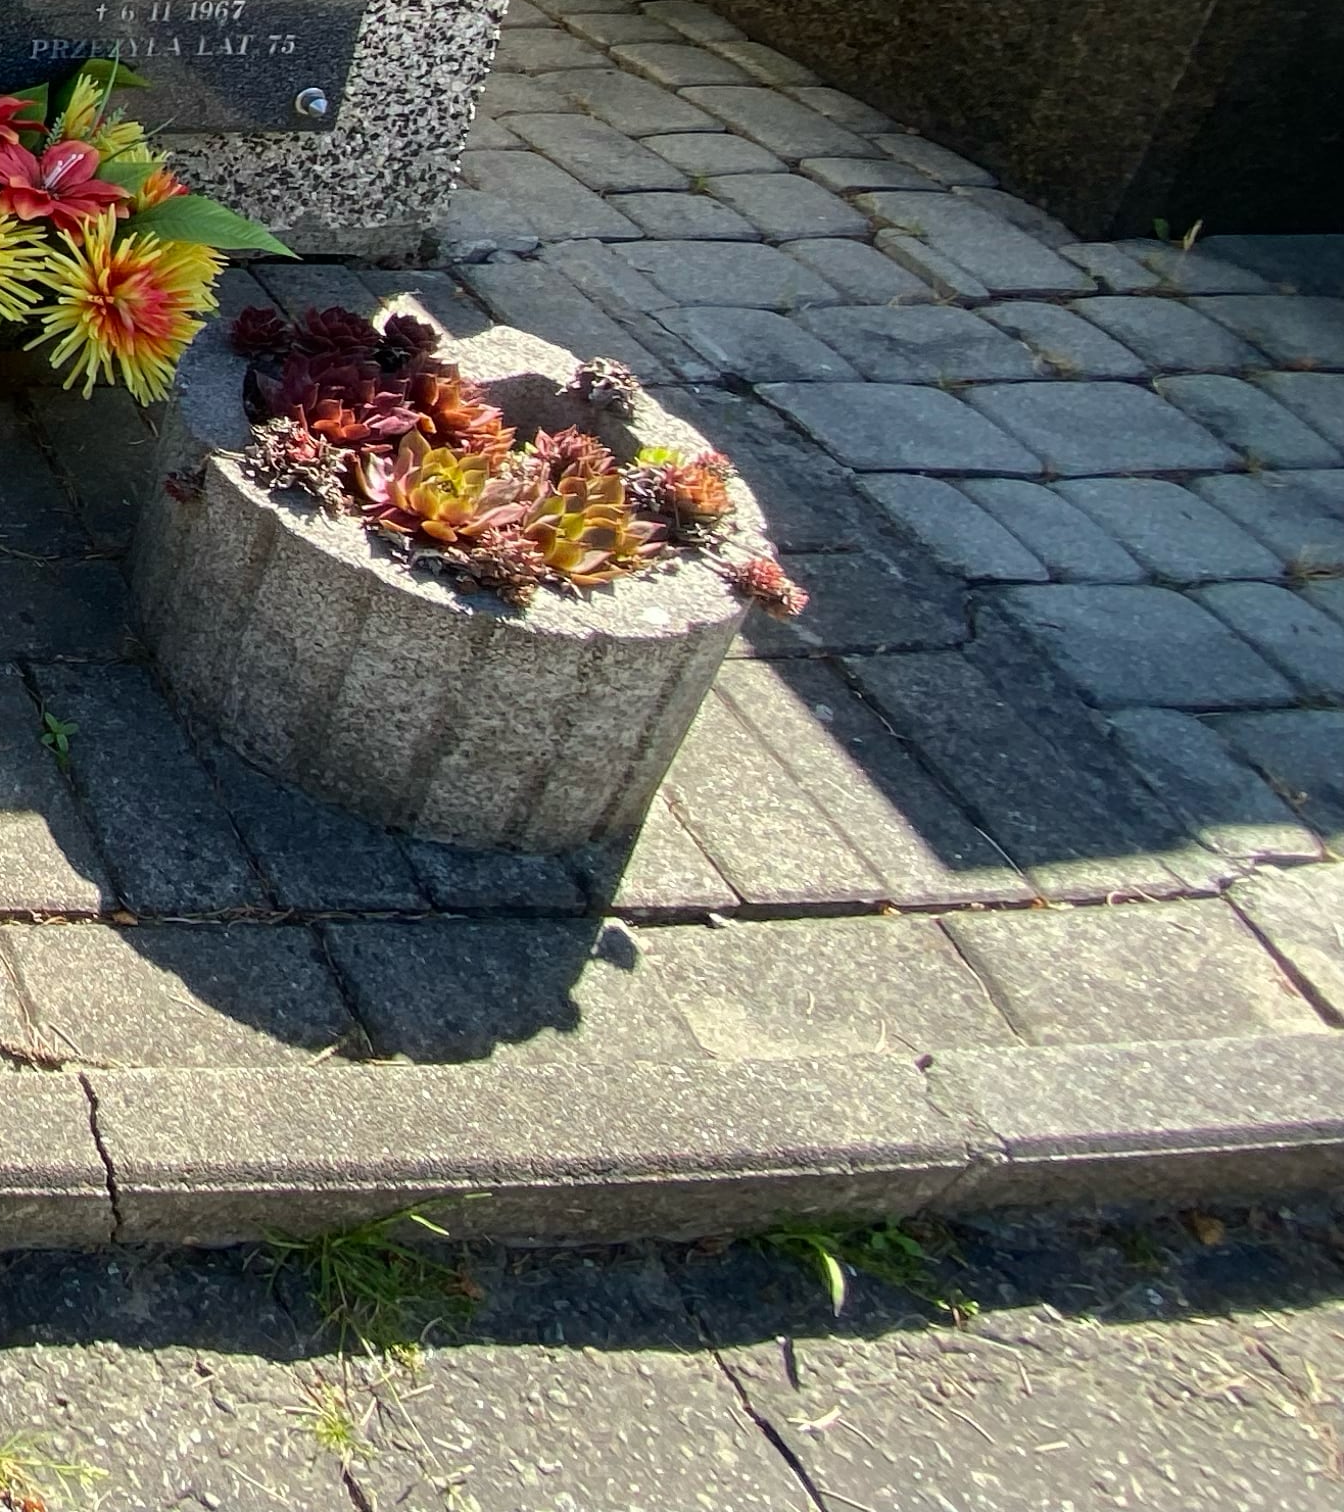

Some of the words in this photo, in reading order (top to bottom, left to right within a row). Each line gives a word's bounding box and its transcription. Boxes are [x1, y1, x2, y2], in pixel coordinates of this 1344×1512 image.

[188, 0, 247, 21] 1967
[195, 34, 255, 57] LAT
[267, 33, 297, 56] 75
